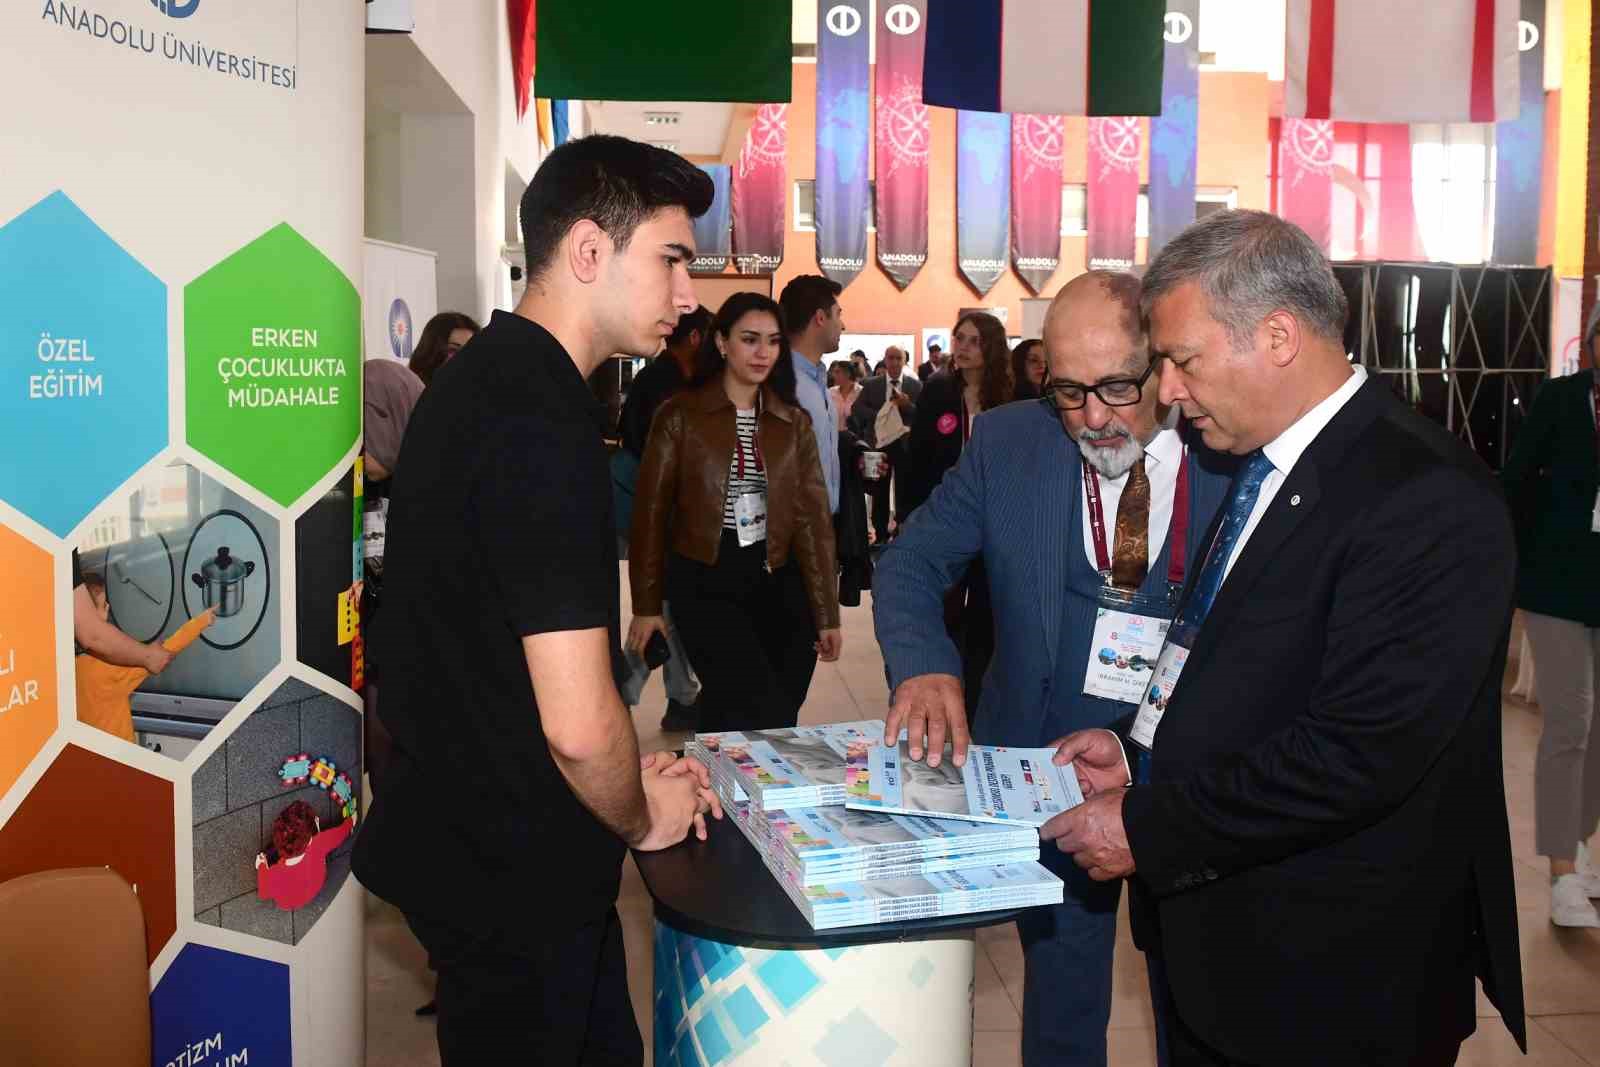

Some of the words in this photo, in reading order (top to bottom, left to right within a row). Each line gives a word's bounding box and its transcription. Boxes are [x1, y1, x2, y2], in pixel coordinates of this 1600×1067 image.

[42, 1, 155, 53] ANADOLU
[162, 32, 297, 90] ÜNİVERSİTESİ
[820, 257, 864, 267] ANADOLU
[882, 253, 926, 262] ANADOLU
[1017, 257, 1058, 266] ANADOLU
[37, 332, 96, 363] ÖZEL
[252, 327, 318, 348] ERKEN
[218, 356, 347, 384] ÇOCUKLUKTA
[29, 368, 104, 399] EĞİTİM
[228, 384, 340, 409] MÜDAHALE
